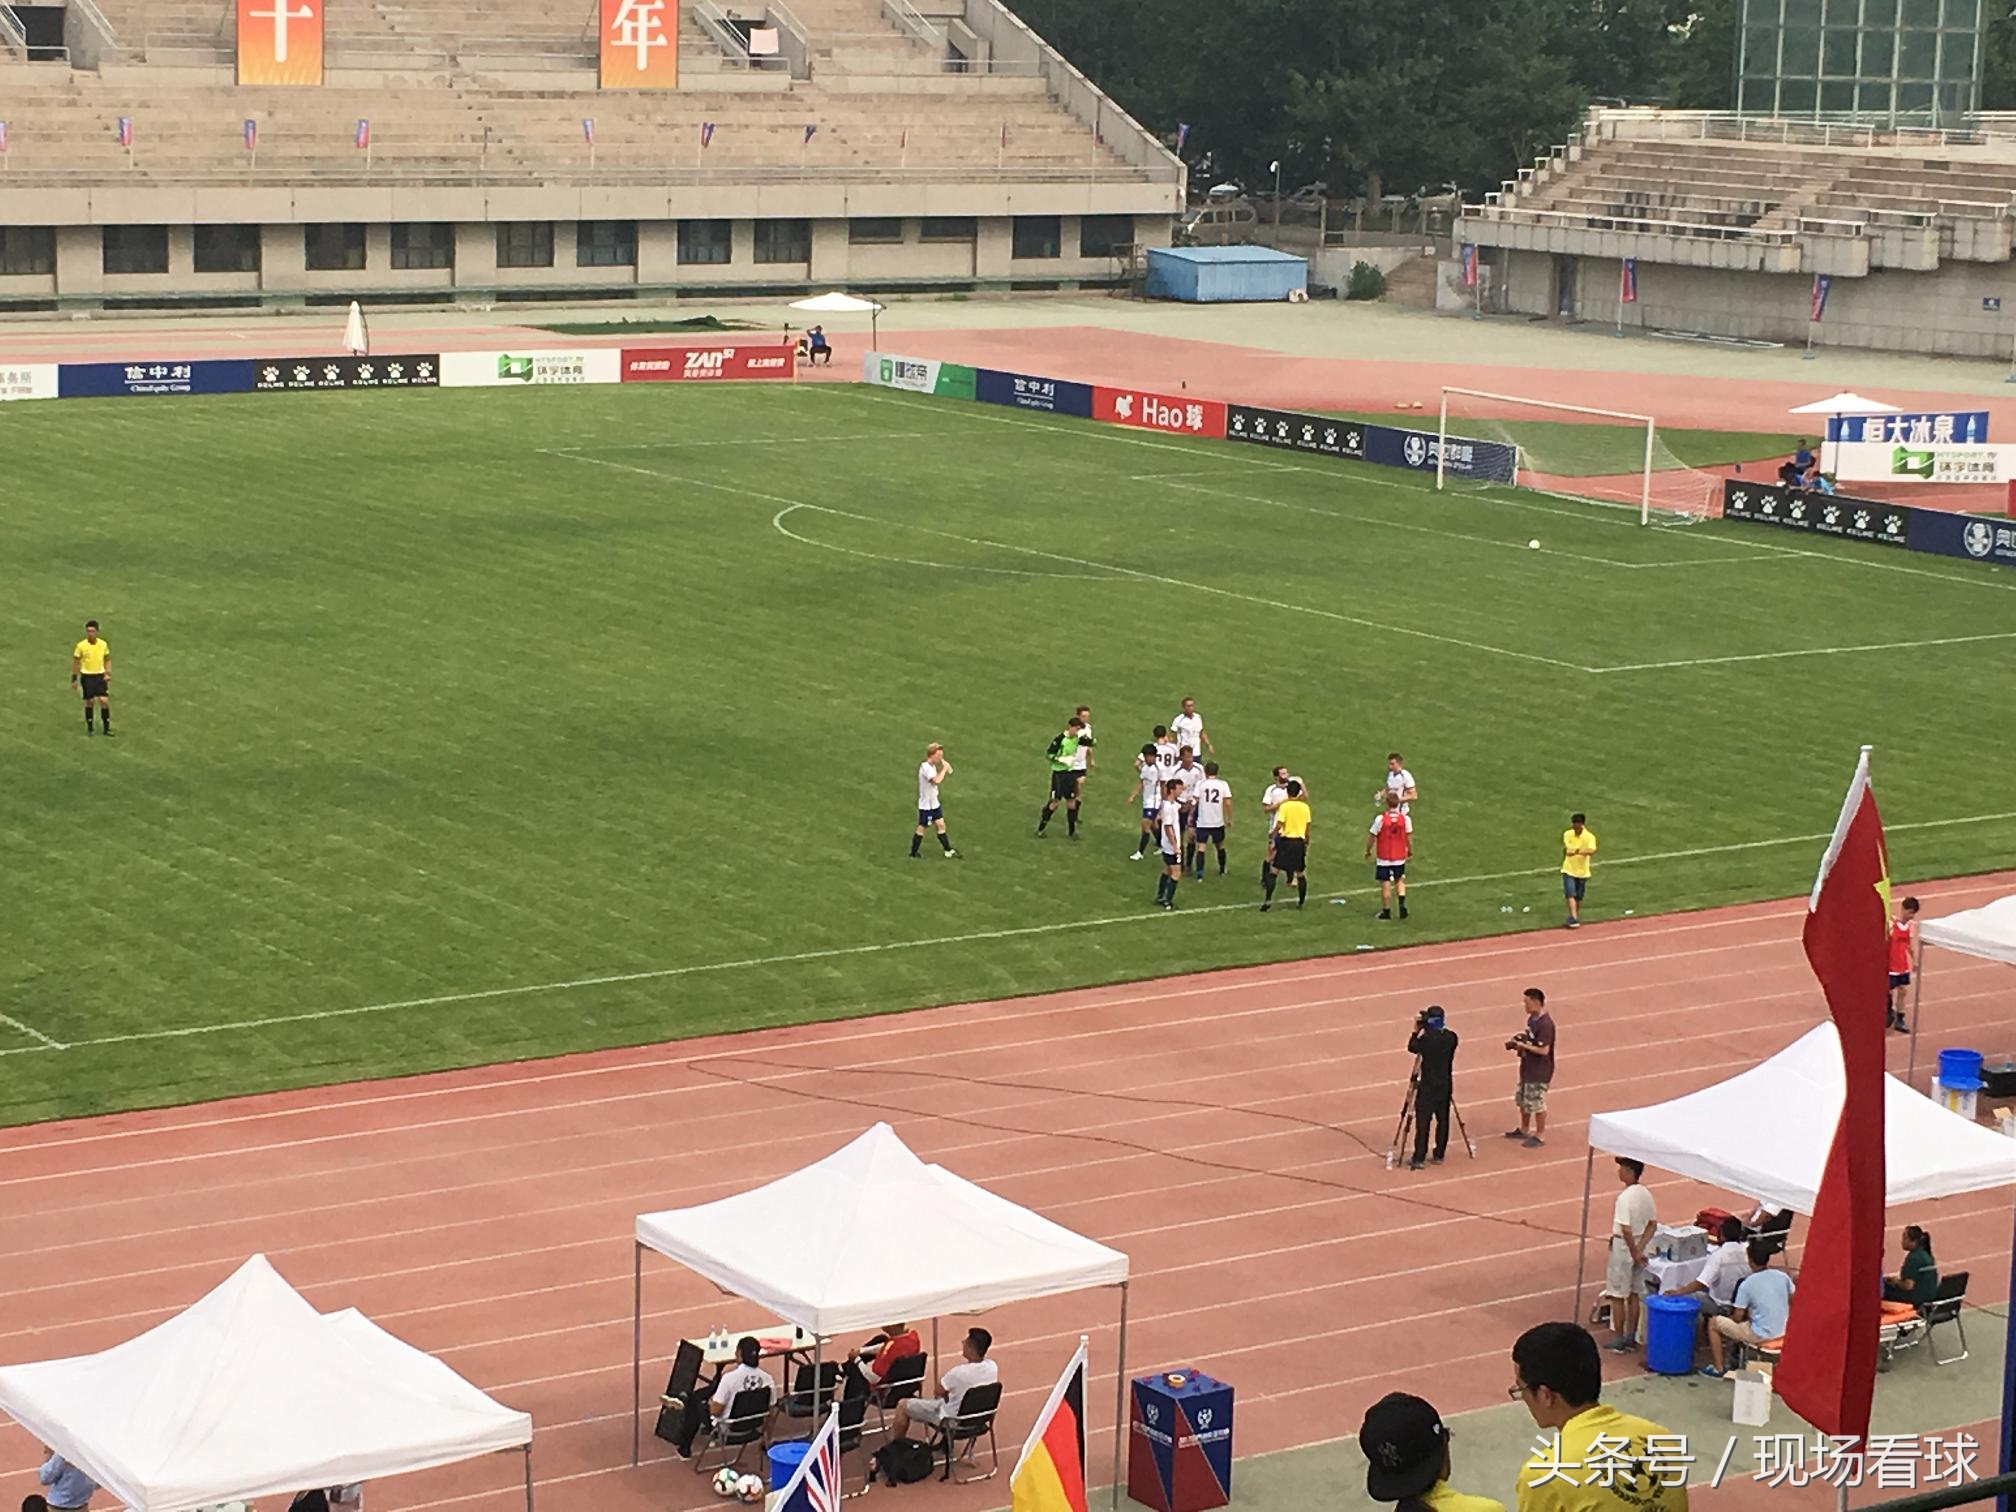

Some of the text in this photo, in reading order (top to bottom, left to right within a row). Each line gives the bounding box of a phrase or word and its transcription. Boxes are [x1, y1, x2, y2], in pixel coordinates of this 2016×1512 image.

[610, 0, 668, 71] 年
[1862, 415, 1955, 444] 恒大冰泉
[1205, 788, 1219, 803] 12
